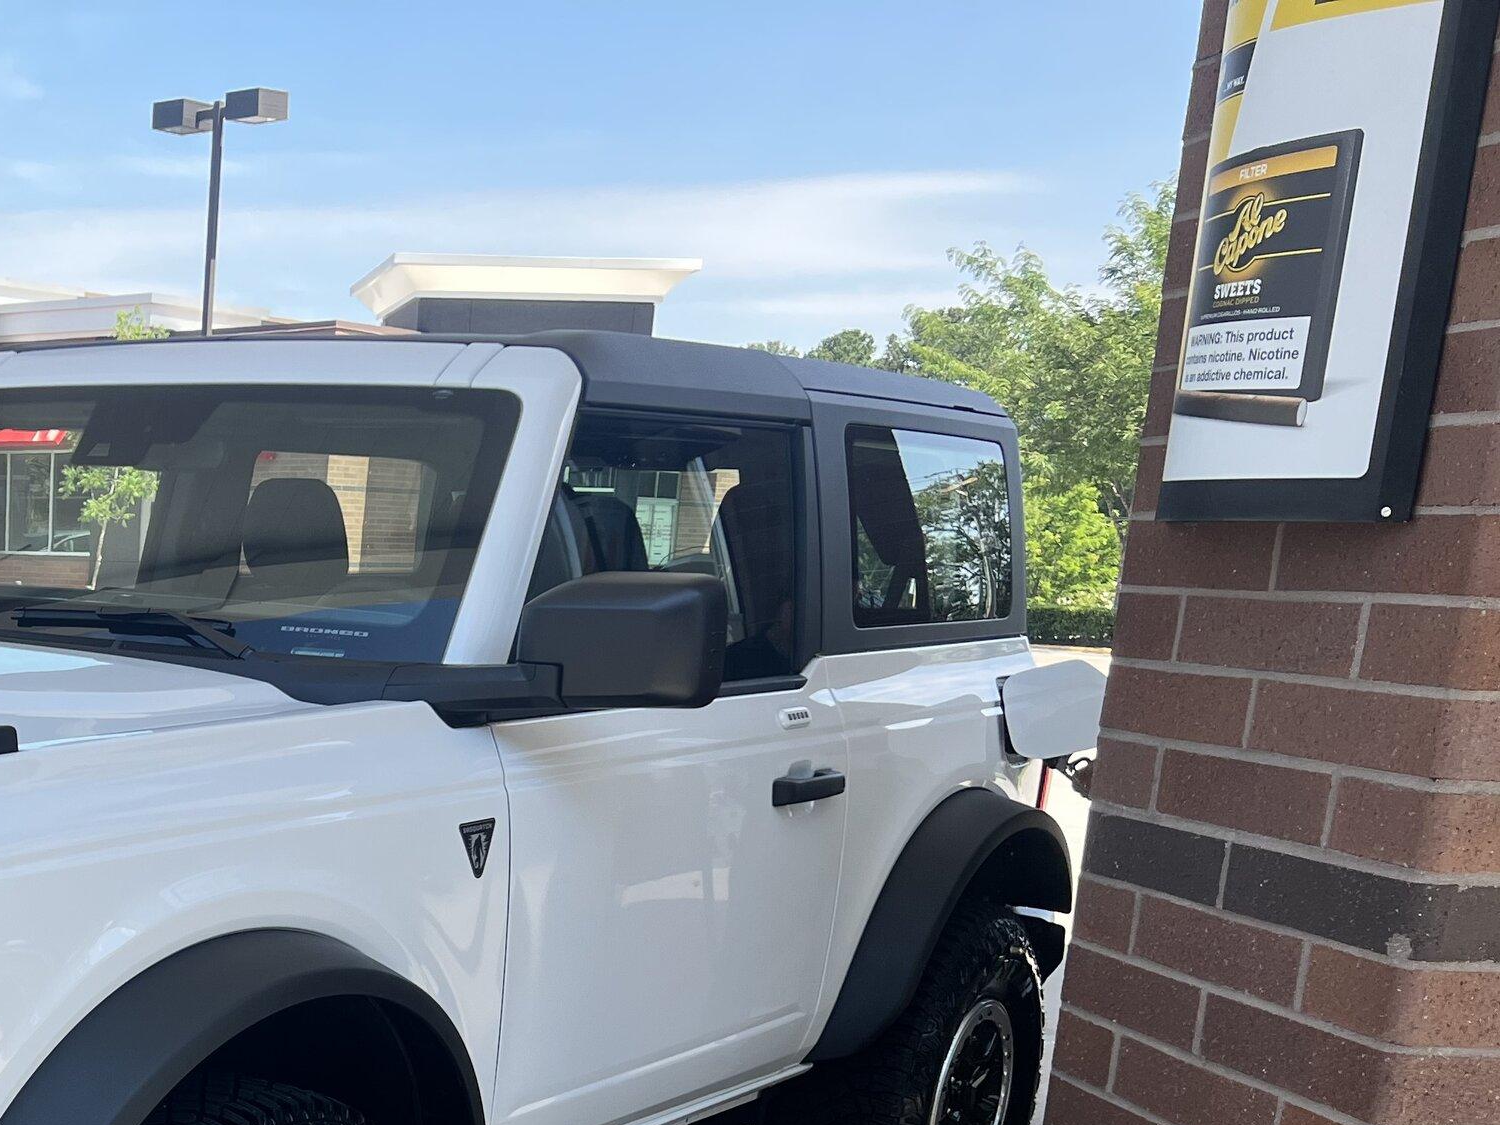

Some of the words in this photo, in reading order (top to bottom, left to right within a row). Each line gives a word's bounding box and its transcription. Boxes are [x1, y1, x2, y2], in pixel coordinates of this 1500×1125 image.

[1239, 164, 1268, 181] FILTER
[1229, 191, 1265, 241] Al
[1213, 208, 1288, 275] Capone
[1213, 278, 1262, 300] SWEETS
[1235, 296, 1260, 305] DIPPED
[1225, 331, 1244, 343] This
[1246, 328, 1295, 344] product
[1208, 350, 1245, 364] nicotine.
[1248, 347, 1299, 361] Nicotine
[1196, 369, 1231, 382] addictive
[1233, 367, 1289, 381] chemical.
[280, 625, 369, 637] BRONCO
